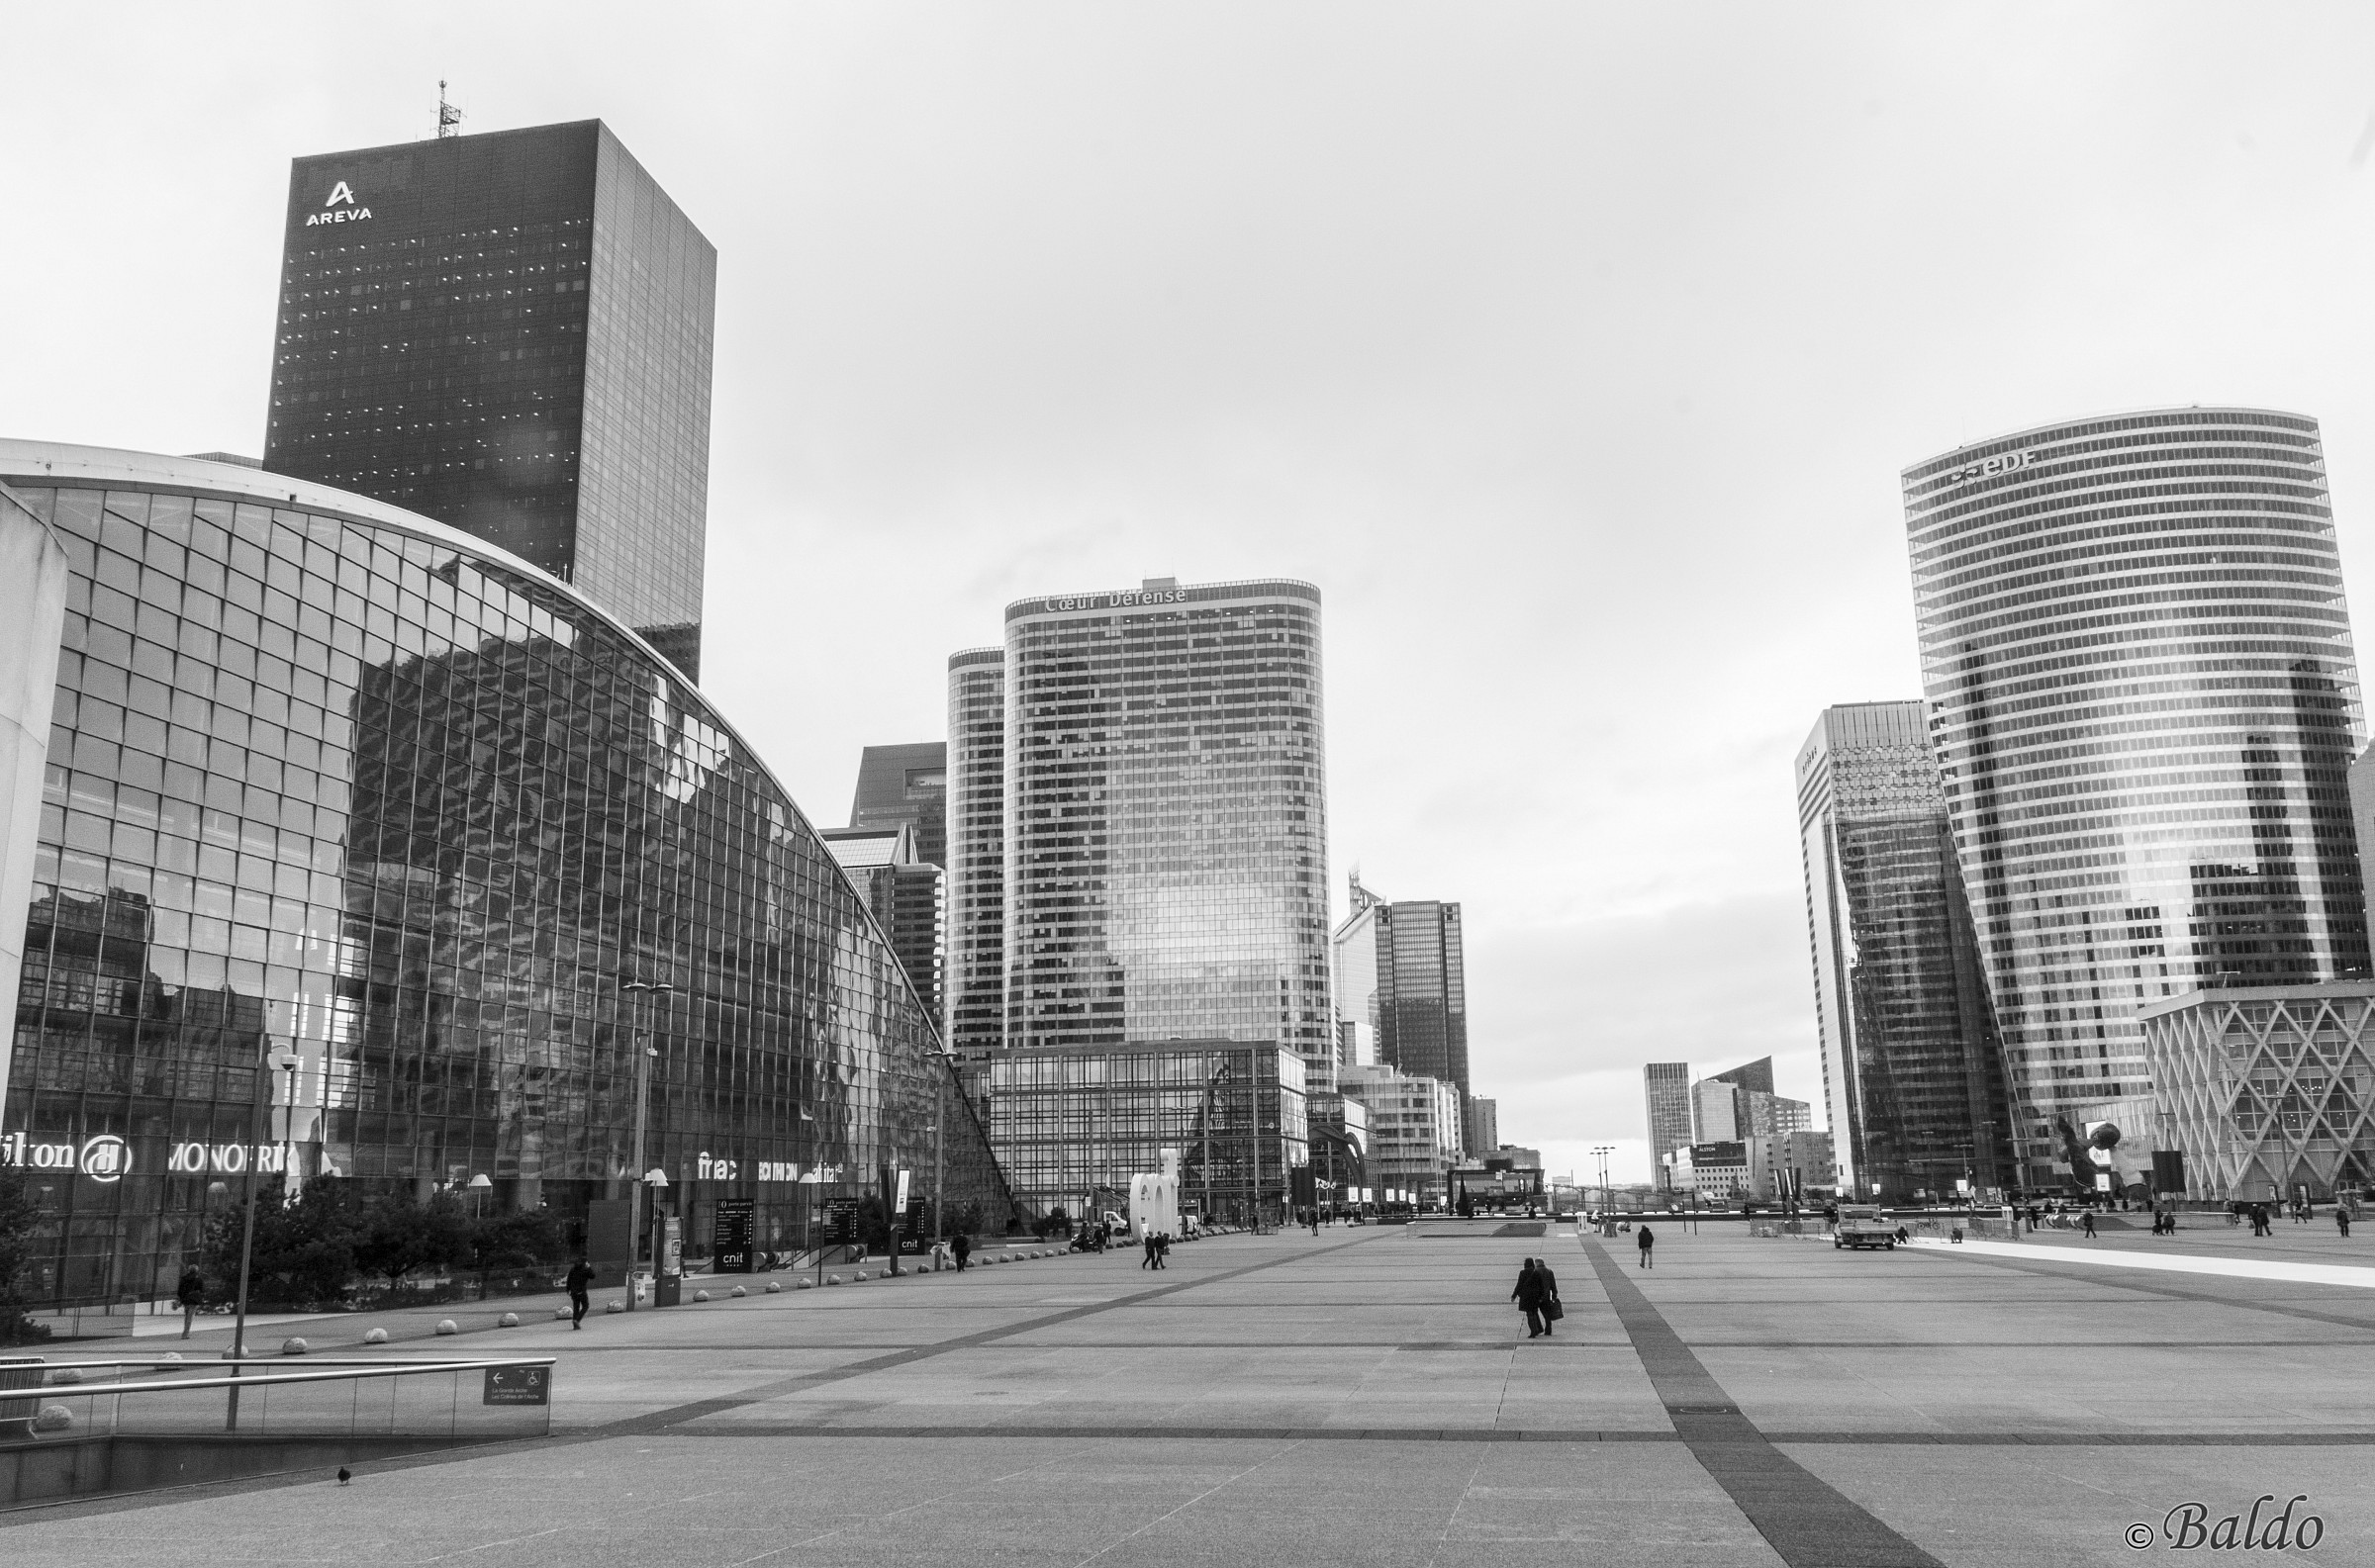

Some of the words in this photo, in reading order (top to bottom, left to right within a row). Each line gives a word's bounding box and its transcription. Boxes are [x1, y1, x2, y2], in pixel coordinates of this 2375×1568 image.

[306, 208, 372, 226] AREVA
[902, 1239, 918, 1248] cnit
[722, 1251, 744, 1263] cnit
